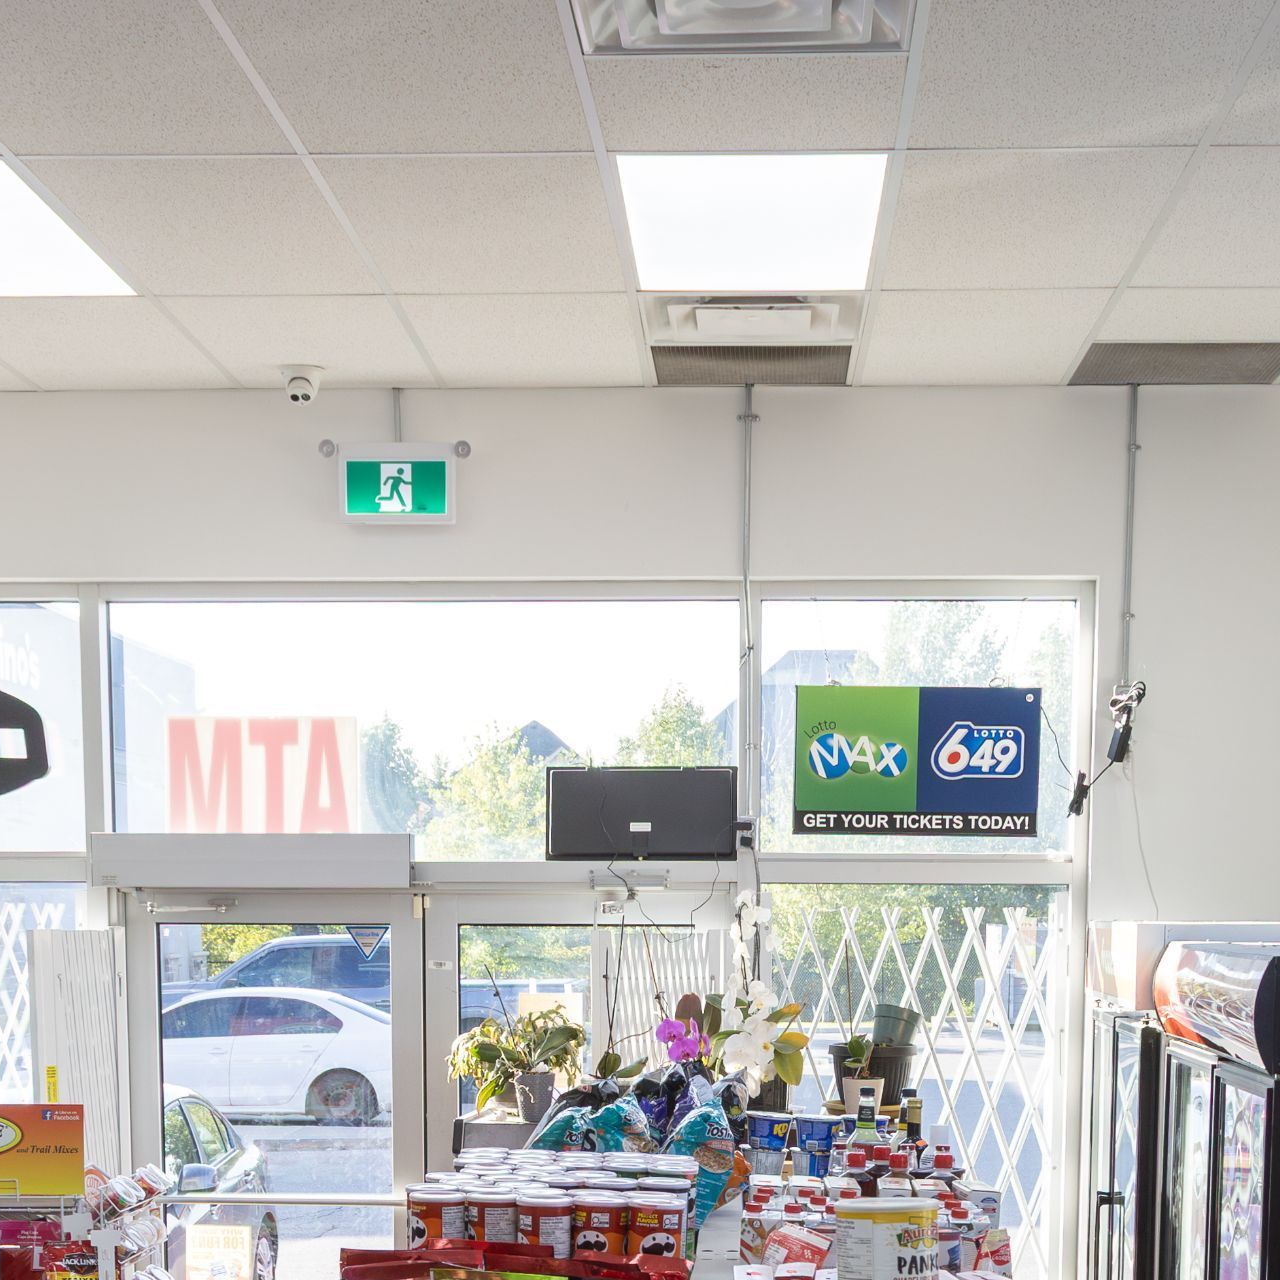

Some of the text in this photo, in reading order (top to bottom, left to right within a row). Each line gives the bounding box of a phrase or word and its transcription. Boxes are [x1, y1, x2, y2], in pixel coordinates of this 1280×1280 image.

[803, 719, 837, 739] Lotto
[974, 729, 1014, 738] LOTTO
[809, 732, 904, 779] MAX
[803, 813, 1030, 831] GET YOUR TICKETS TODAY!
[29, 1145, 51, 1154] Trail
[53, 1145, 80, 1154] Mixes
